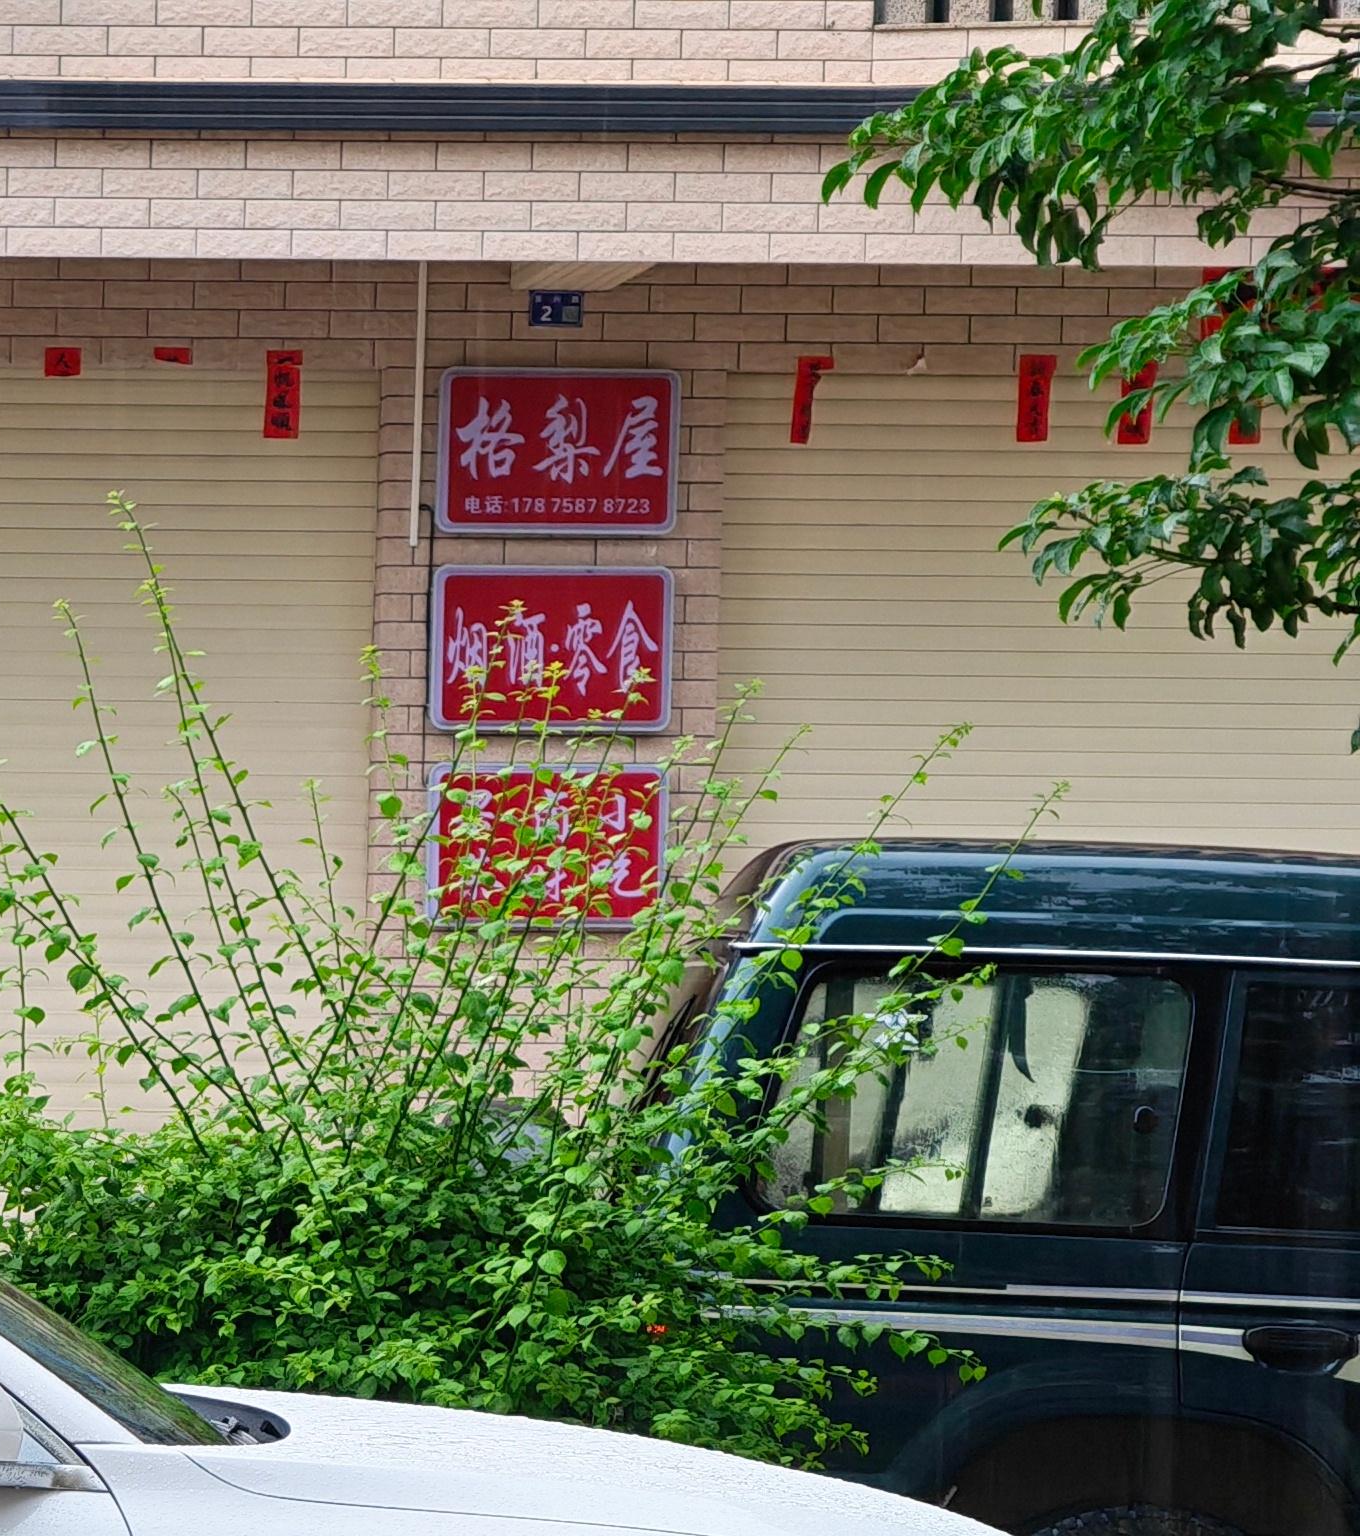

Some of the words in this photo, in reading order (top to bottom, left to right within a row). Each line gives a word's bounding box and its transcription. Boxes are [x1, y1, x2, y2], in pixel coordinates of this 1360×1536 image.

[512, 497, 545, 513] 178
[552, 497, 597, 514] 7587
[603, 498, 650, 514] 8723
